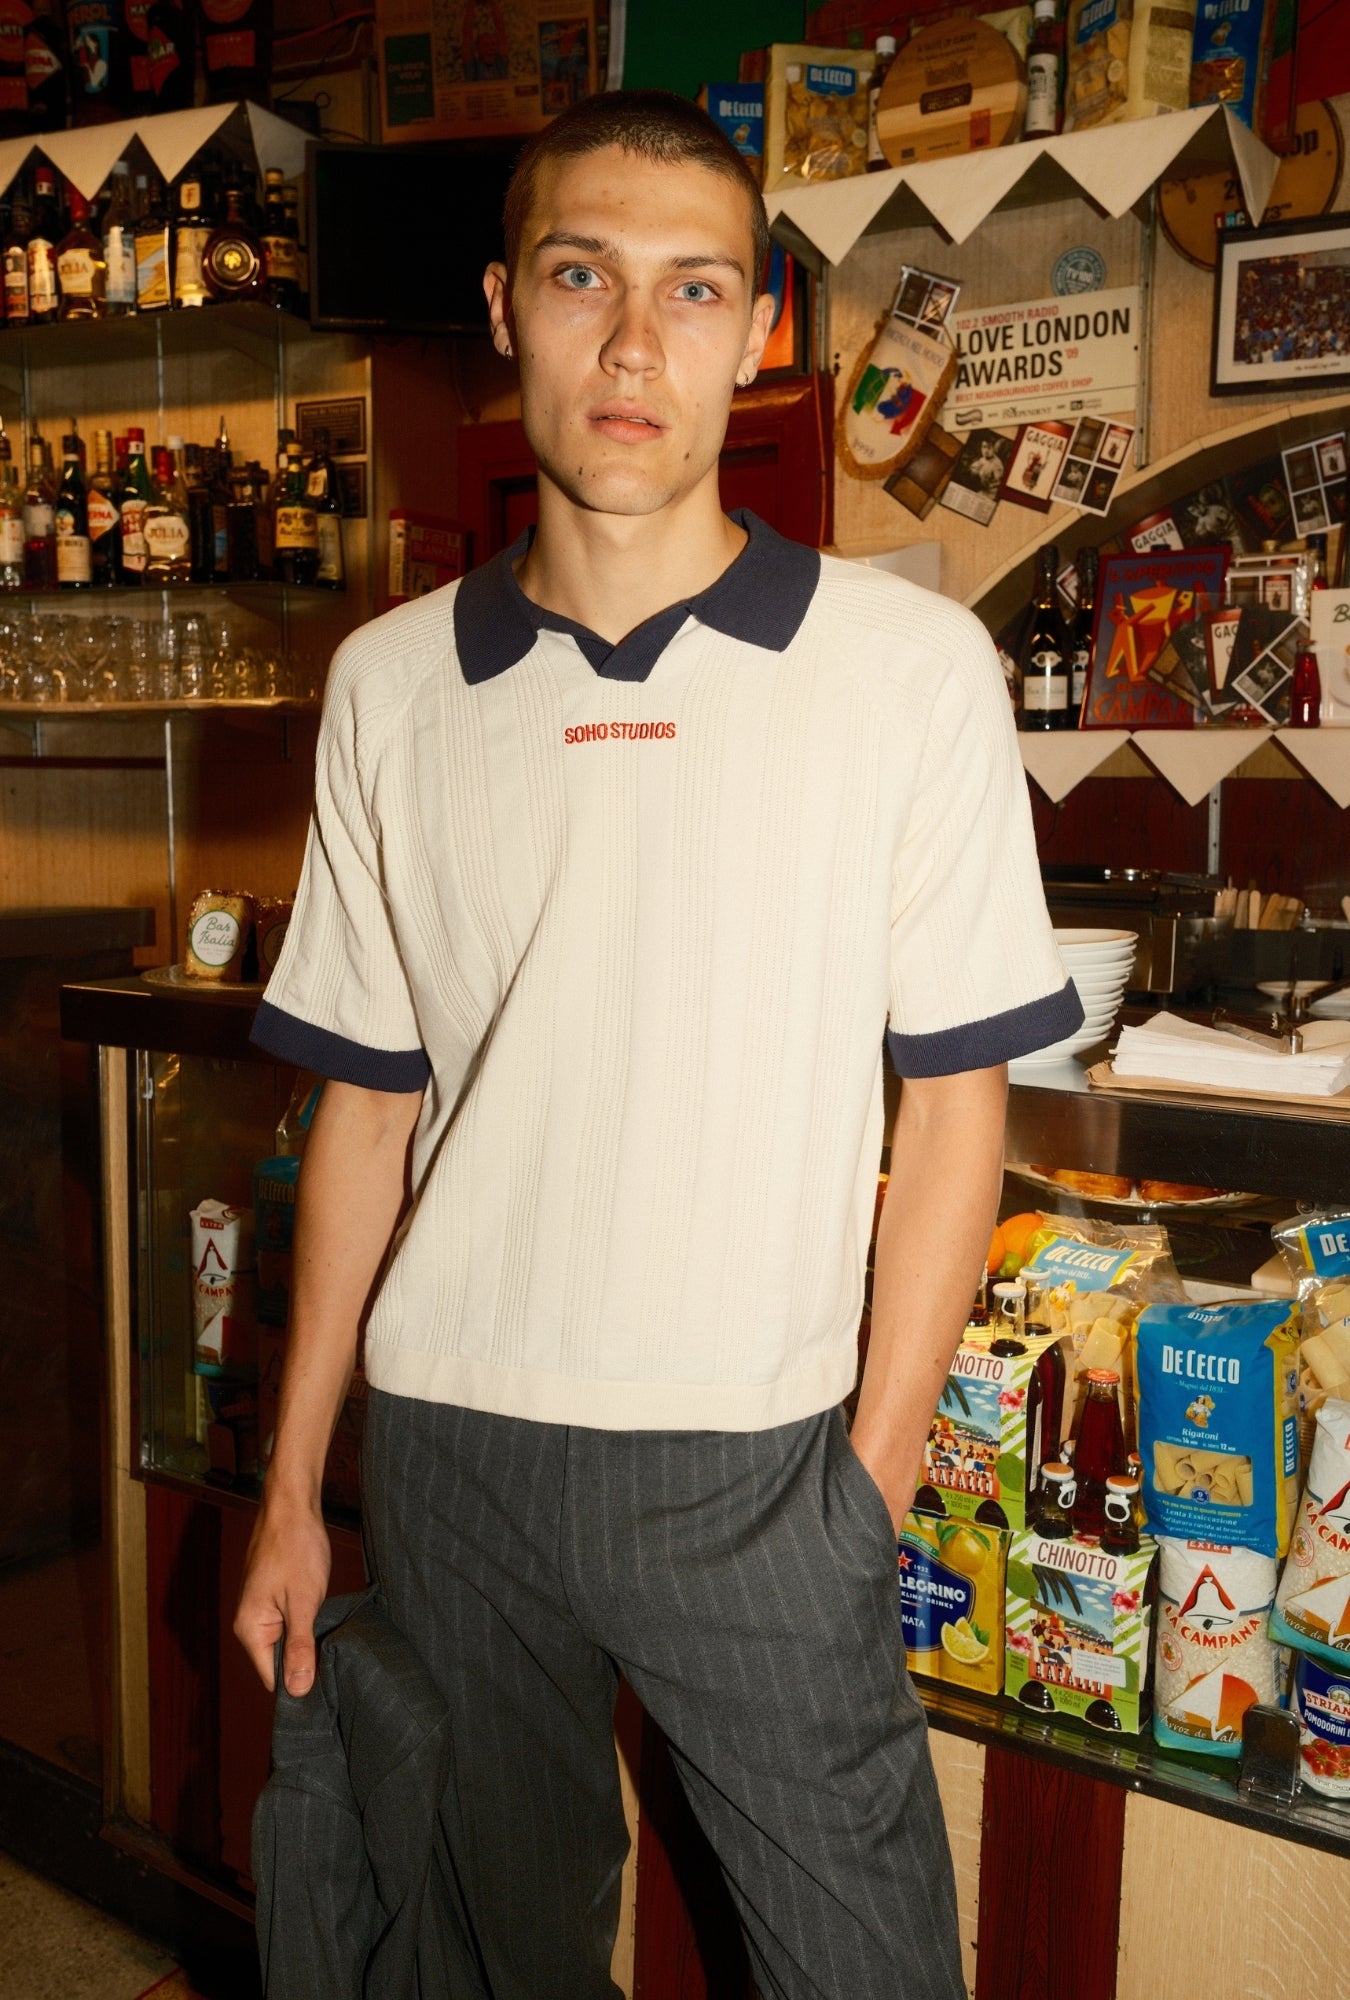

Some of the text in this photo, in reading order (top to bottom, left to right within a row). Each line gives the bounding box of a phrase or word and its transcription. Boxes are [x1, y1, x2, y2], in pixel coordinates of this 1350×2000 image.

[982, 311, 1025, 327] SMOOTH
[1027, 305, 1060, 318] RADIO
[956, 307, 1131, 359] LOVE LONDON
[955, 350, 1063, 389] AWARDS
[975, 384, 1041, 401] NEIGHBOURHOOD
[1042, 380, 1070, 393] COFFEE
[1071, 377, 1093, 389] SHOP
[1026, 429, 1064, 451] GAGGIA
[1135, 520, 1175, 550] GAGGIA
[1214, 624, 1239, 639] GAG
[1093, 689, 1189, 724] CAMPAR
[565, 722, 676, 744] SOHO STUDIOS
[206, 916, 231, 932] Bar
[198, 930, 235, 947] Italia
[1319, 1233, 1349, 1257] DE
[1044, 1245, 1120, 1272] DE CECCO
[953, 1353, 1004, 1381] NOTTO
[1162, 1345, 1240, 1385] DE CECCO
[1182, 1428, 1219, 1441] Rigatoni
[1284, 1422, 1295, 1457] CECCO
[928, 1467, 993, 1495] RAPALLO
[1165, 1508, 1238, 1526] Lenta Essiccazione
[1306, 1502, 1350, 1552] LA CAM
[1189, 1539, 1229, 1552] EXTRA
[1037, 1541, 1118, 1581] CHINOTTO
[899, 1574, 967, 1603] LEGRINO
[901, 1590, 954, 1610] KLING DRINKS
[901, 1613, 926, 1629] NATA
[1165, 1605, 1261, 1649] LA CAMPANA
[1278, 1608, 1350, 1652] Arroz de Val
[1306, 1693, 1350, 1717] STRIAN
[1160, 1715, 1190, 1734] Arroz
[1194, 1728, 1207, 1739] de
[1304, 1708, 1346, 1737] POMODORINI
